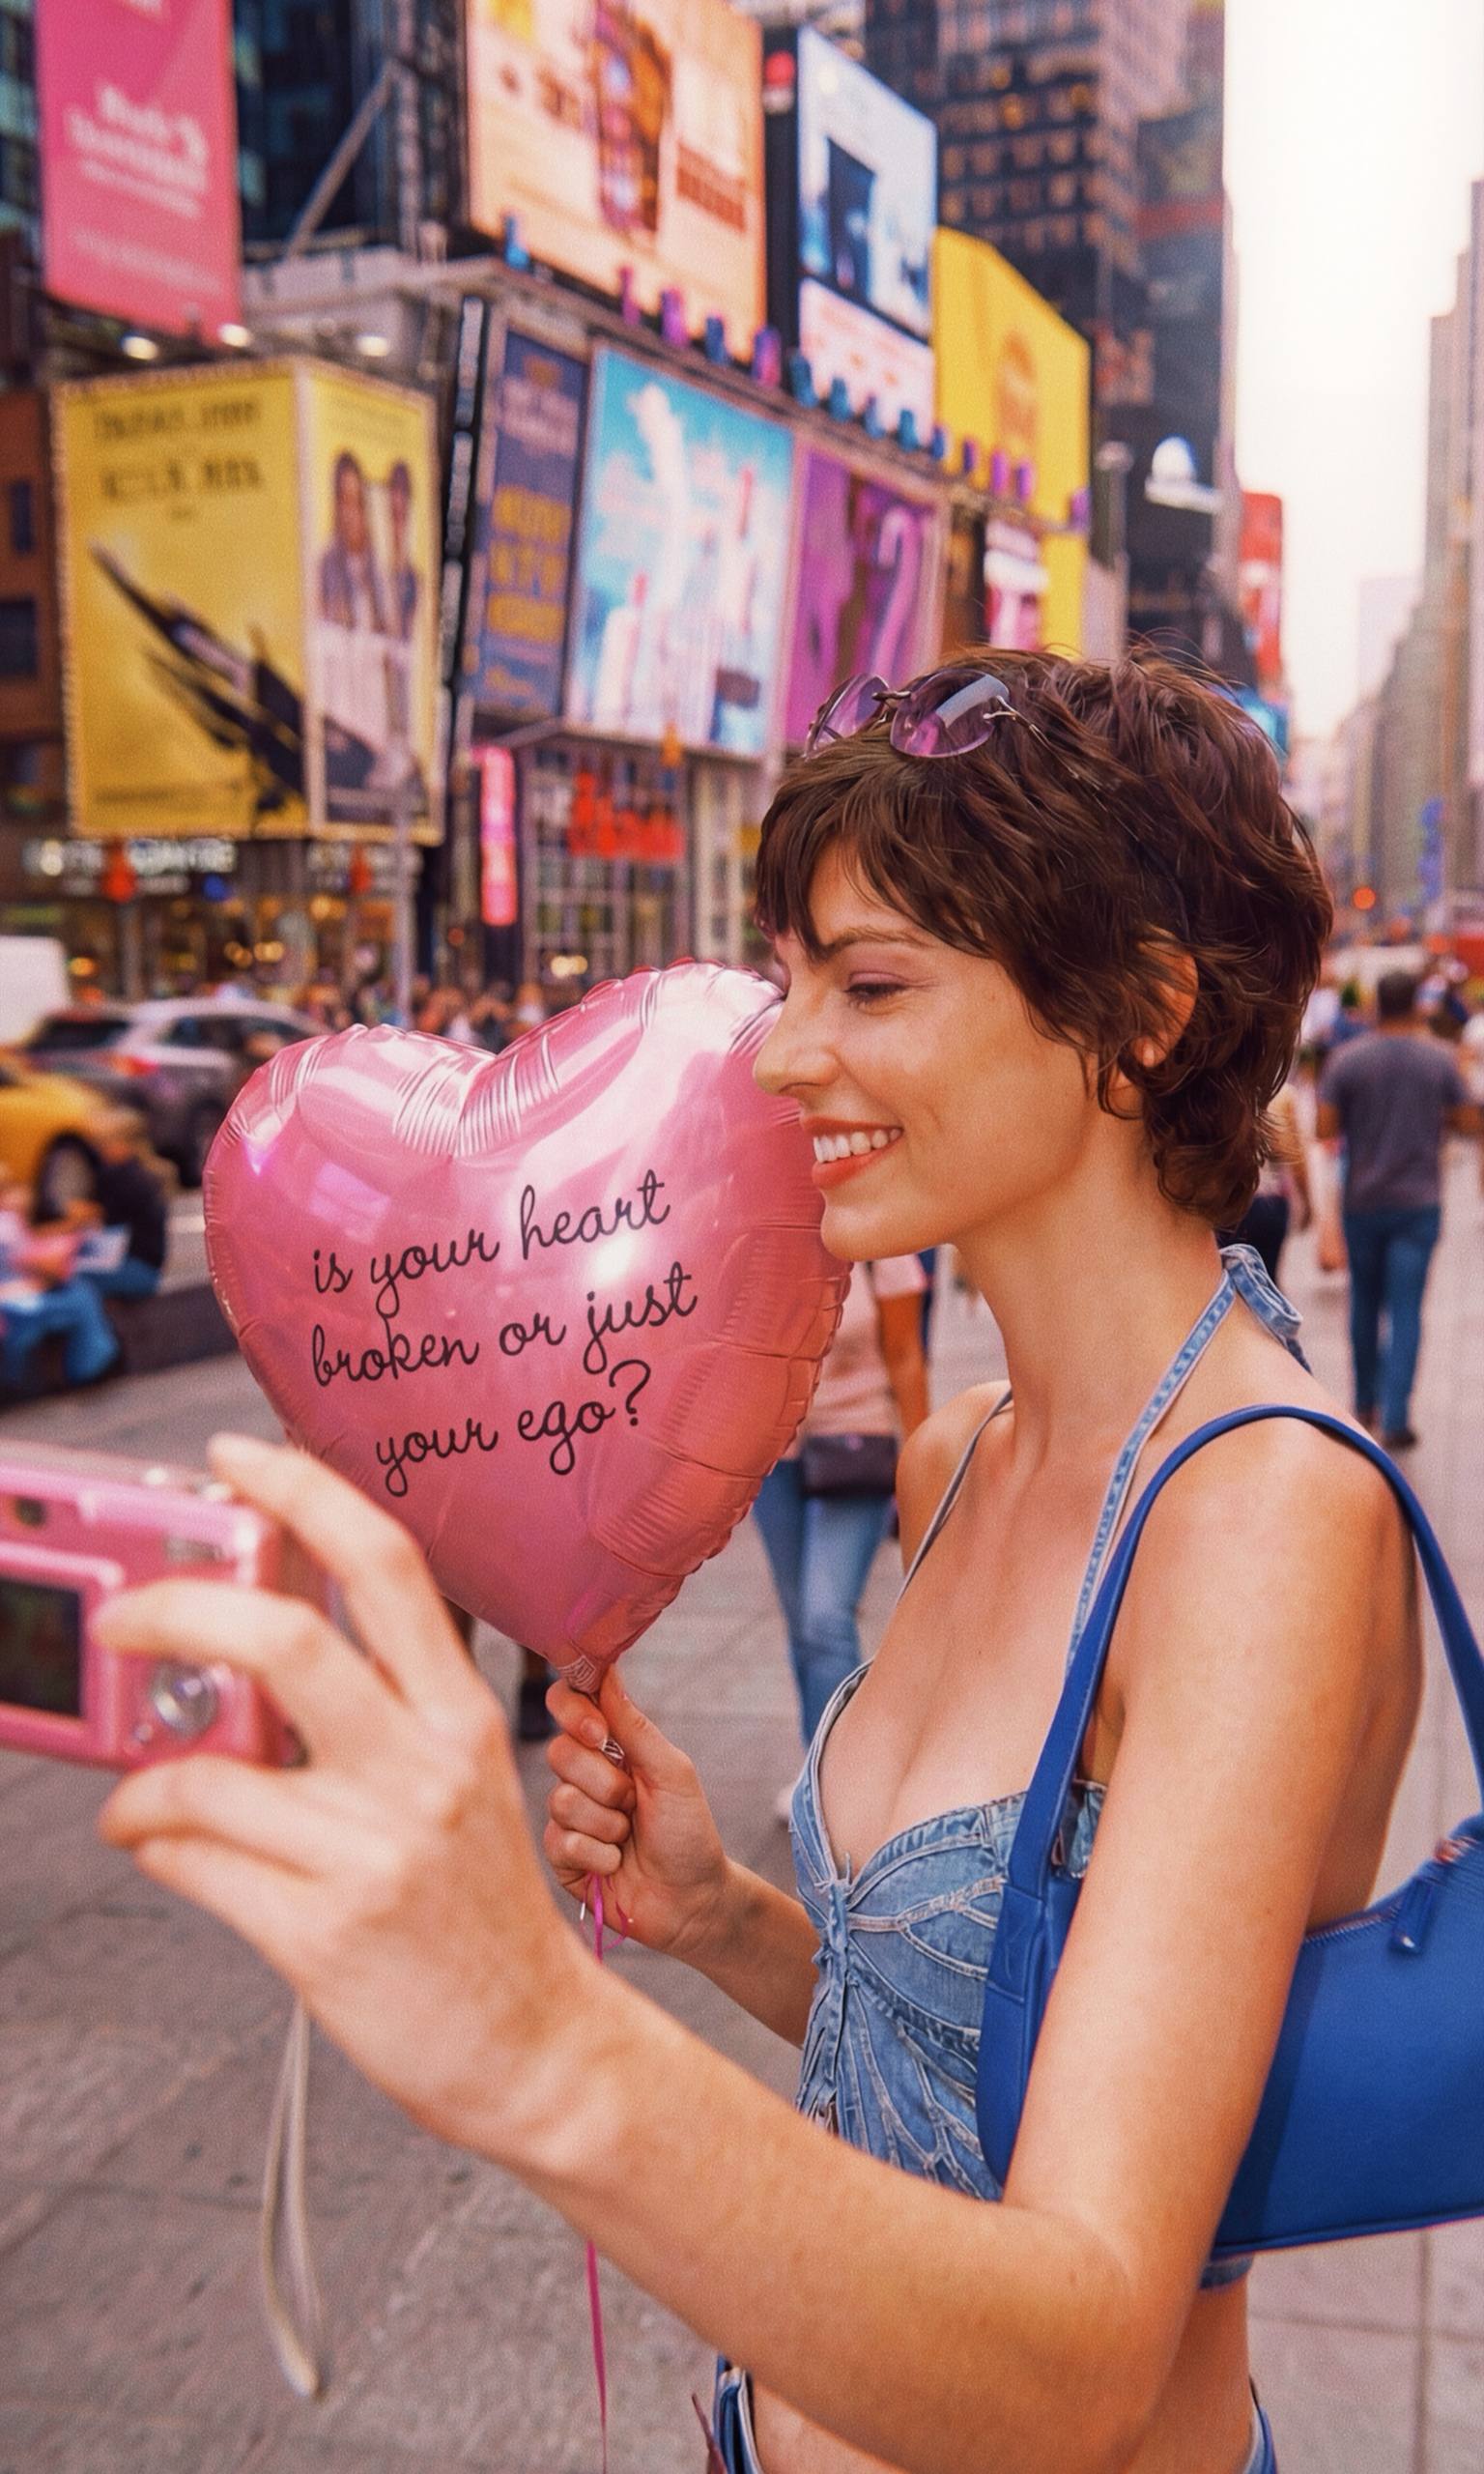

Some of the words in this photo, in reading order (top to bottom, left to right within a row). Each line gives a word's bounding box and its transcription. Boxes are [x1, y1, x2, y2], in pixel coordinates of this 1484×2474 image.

[314, 1250, 353, 1293] is
[370, 1229, 499, 1318] your
[520, 1169, 671, 1260] heart
[312, 1320, 479, 1387] broken
[499, 1312, 566, 1356] or
[583, 1261, 698, 1374] just
[375, 1418, 499, 1497] your
[516, 1359, 651, 1475] ego?
